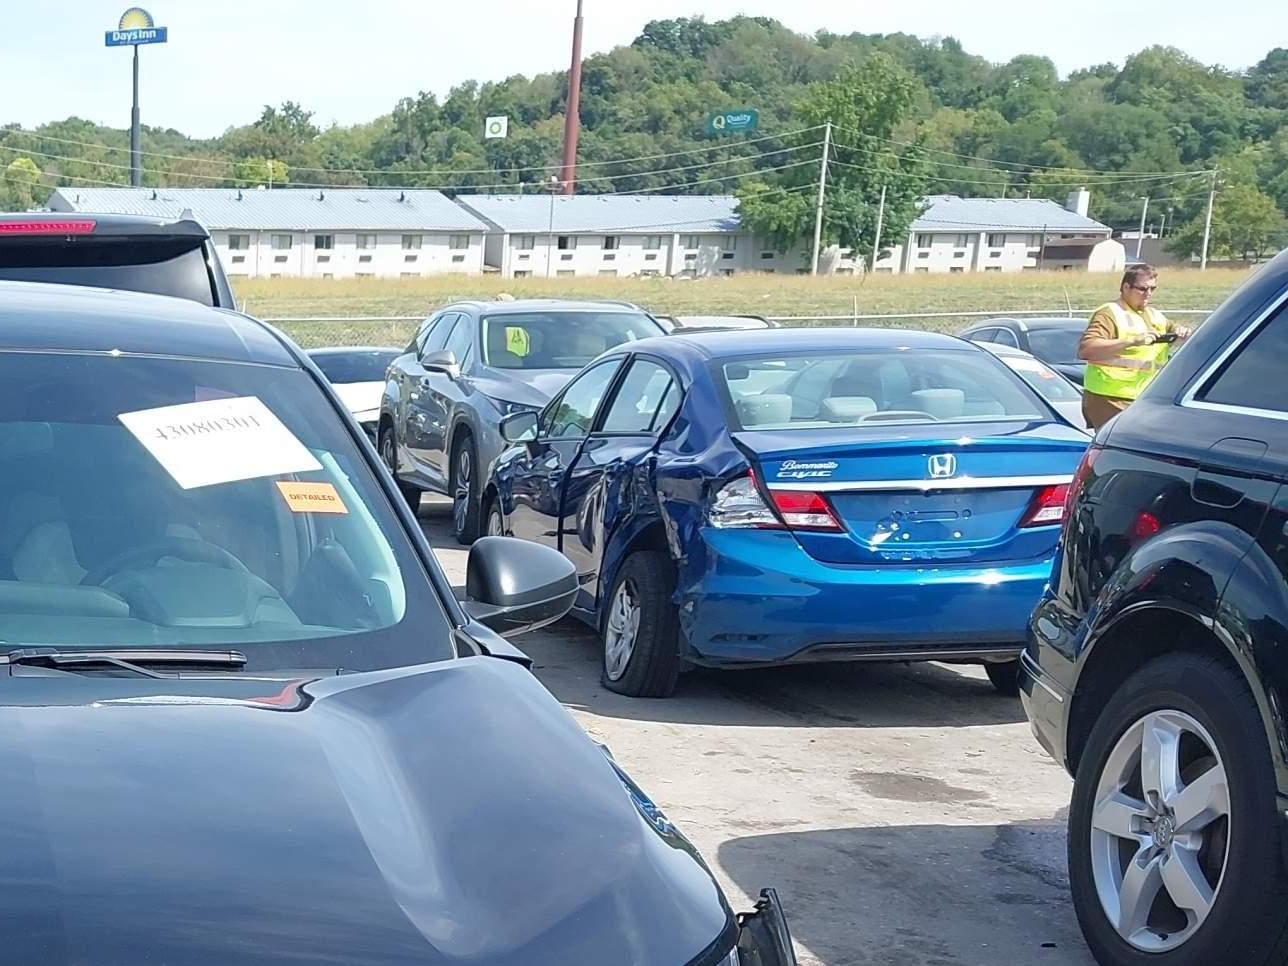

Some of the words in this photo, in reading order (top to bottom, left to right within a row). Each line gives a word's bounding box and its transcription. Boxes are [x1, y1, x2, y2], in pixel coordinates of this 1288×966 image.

[112, 31, 138, 42] Days
[139, 29, 157, 39] Inn
[155, 415, 261, 441] 43080301
[289, 493, 336, 502] DETAILED
